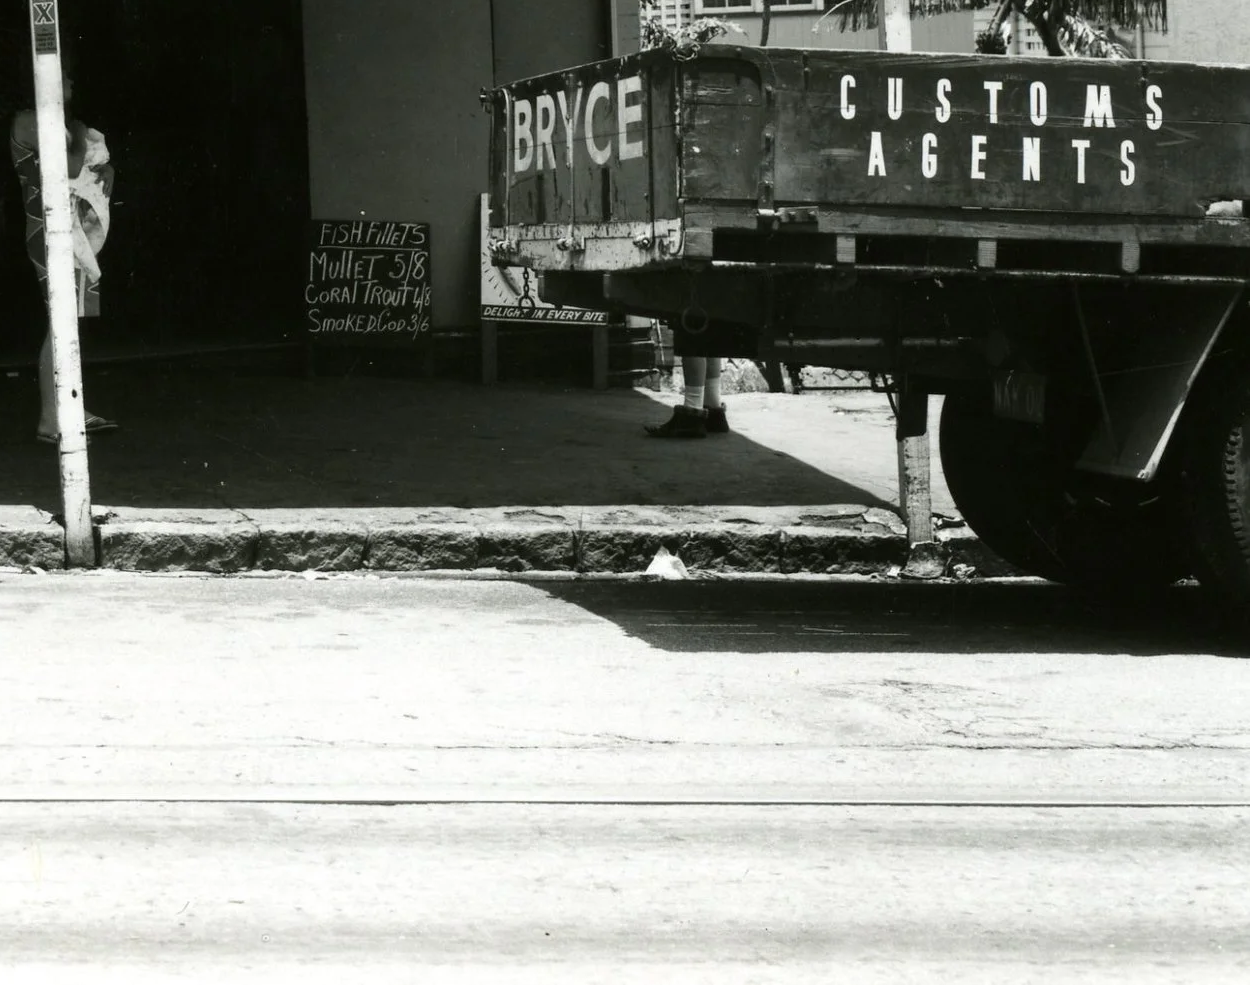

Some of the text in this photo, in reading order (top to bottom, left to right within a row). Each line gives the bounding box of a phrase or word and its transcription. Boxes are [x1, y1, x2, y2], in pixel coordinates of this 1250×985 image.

[514, 76, 644, 173] BRYCE
[840, 74, 1163, 131] CUSTOMS
[867, 131, 1136, 186] AGENTS
[531, 309, 546, 320] IN
[546, 309, 582, 321] EVERY
[582, 311, 606, 322] BITE
